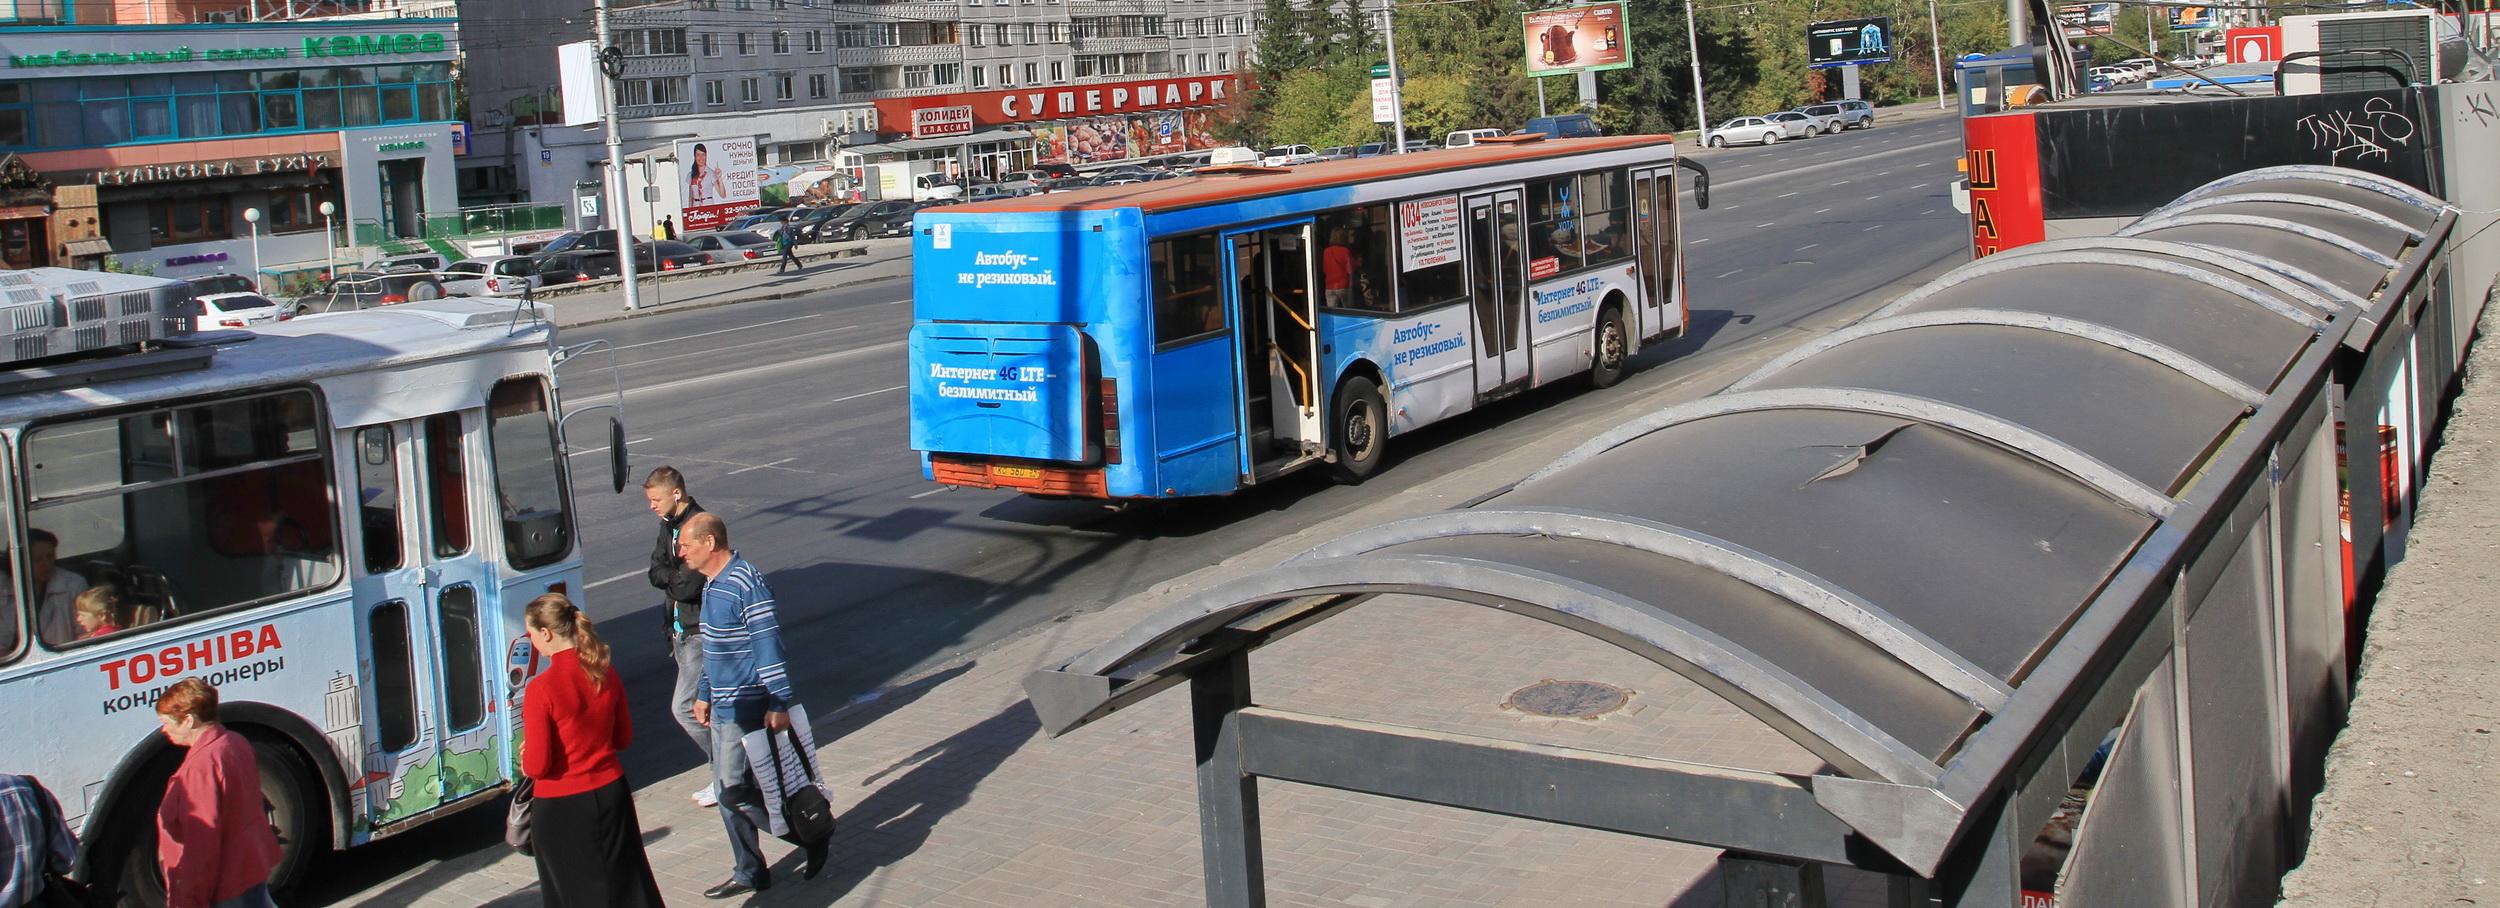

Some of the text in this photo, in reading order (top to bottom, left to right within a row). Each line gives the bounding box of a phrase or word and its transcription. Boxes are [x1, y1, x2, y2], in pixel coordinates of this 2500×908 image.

[919, 107, 970, 122] ХОЛИДЕЙ
[923, 123, 969, 134] КЛАССИК
[542, 150, 550, 160] 19
[722, 141, 753, 151] СРОЧНО
[729, 151, 753, 159] НУЖНЫ
[727, 171, 754, 180] КРЕДИТ
[732, 180, 756, 189] ПОСЛЕ
[1967, 149, 1998, 258] ША
[1400, 202, 1421, 228] 1034
[1559, 221, 1578, 231] YOTA
[975, 250, 1027, 270] Автобус
[958, 269, 1056, 289] не резиновый.
[1537, 287, 1575, 305] Интернет
[1576, 281, 1586, 295] 4G
[1587, 278, 1600, 293] LTE
[1393, 321, 1433, 344] Автобус
[1394, 332, 1466, 366] не резиновый.
[930, 363, 996, 384] Интернет
[999, 366, 1017, 381] 4G
[1020, 367, 1044, 382] LTE
[938, 382, 1038, 401] безлимитный
[100, 624, 282, 690] TOSHIBA
[103, 656, 285, 714] кондонеры
